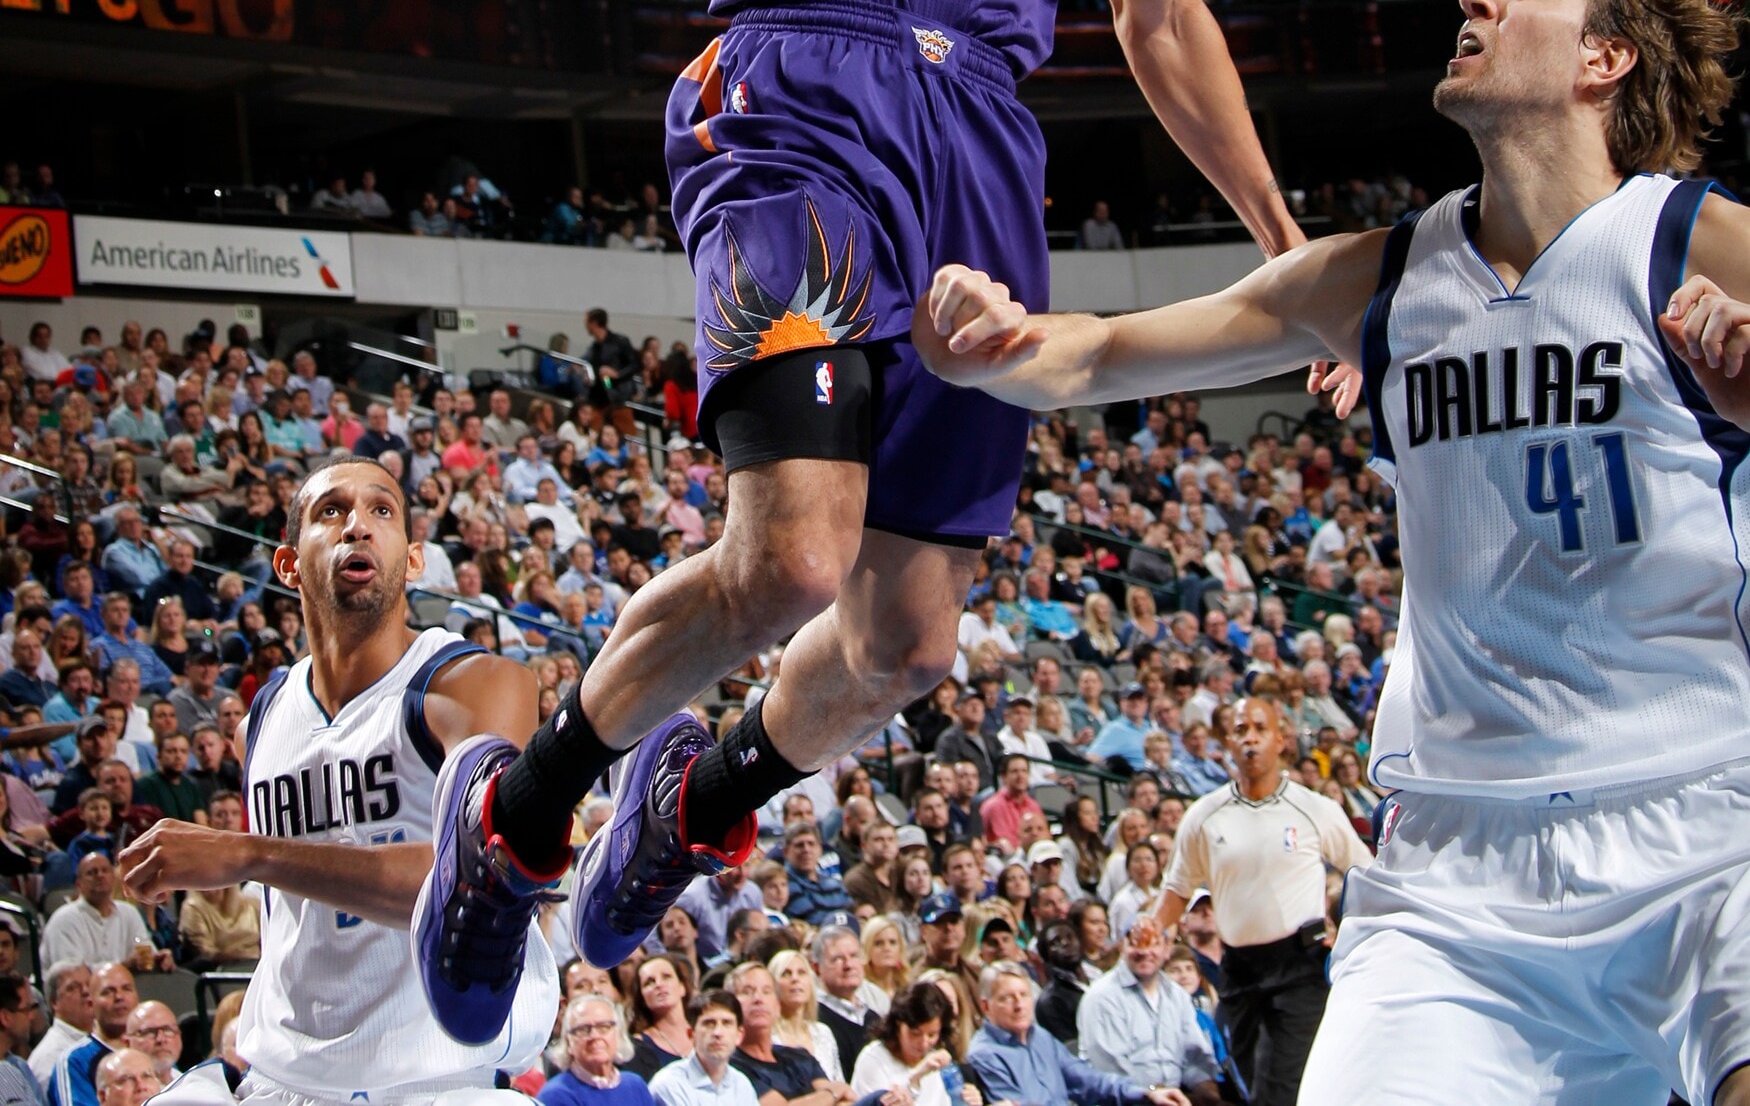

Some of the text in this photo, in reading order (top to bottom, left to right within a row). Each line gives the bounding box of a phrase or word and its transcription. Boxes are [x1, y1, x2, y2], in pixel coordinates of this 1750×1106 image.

[922, 42, 944, 58] PHX
[91, 239, 301, 278] American Airlines
[1403, 339, 1625, 448] DALLAS
[1524, 430, 1645, 556] 41
[252, 754, 401, 838] DALLAS
